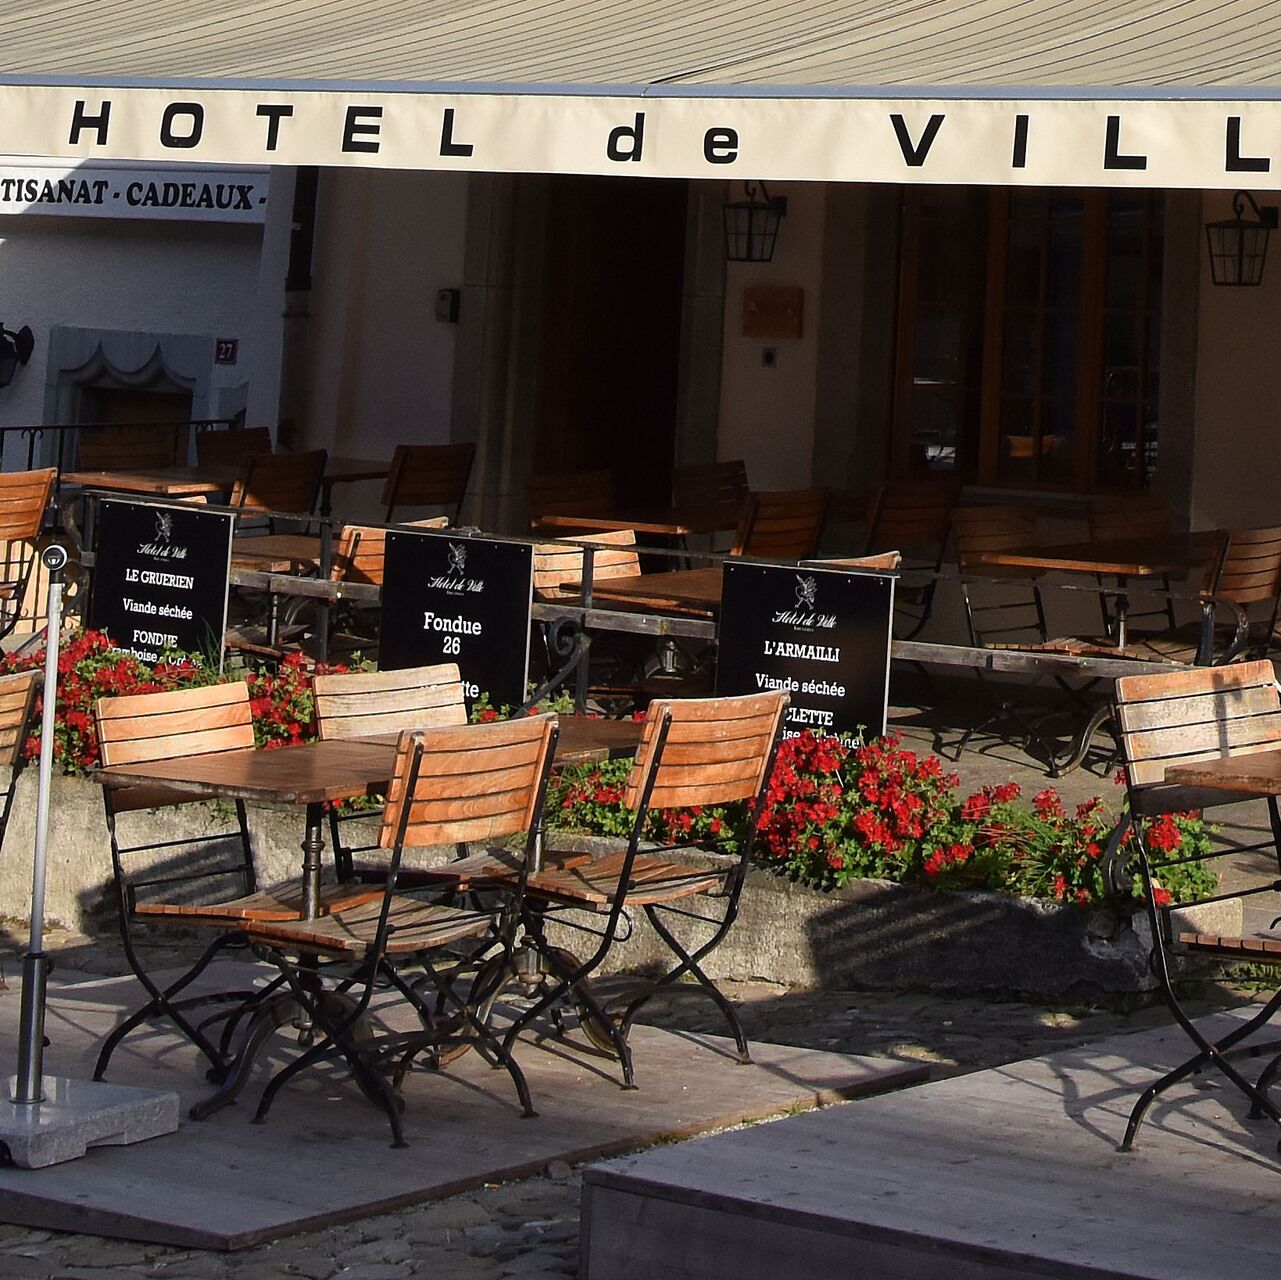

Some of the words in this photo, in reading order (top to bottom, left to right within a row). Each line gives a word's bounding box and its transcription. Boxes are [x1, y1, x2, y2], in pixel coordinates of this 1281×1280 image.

[68, 100, 474, 158] HOTEL
[607, 112, 740, 164] de
[126, 182, 255, 211] CADEAUX
[218, 342, 234, 360] 27
[125, 568, 139, 583] LE
[140, 570, 194, 589] GRUERIEN
[123, 598, 157, 615] Viande
[158, 602, 193, 620] séchée
[423, 611, 482, 635] Fondue
[132, 629, 178, 648] FONDUE
[442, 635, 461, 655] 26
[764, 640, 840, 662] L'ARMAILLI
[755, 673, 799, 691] Viande
[801, 679, 846, 697] séchée
[786, 707, 834, 726] LETTE
